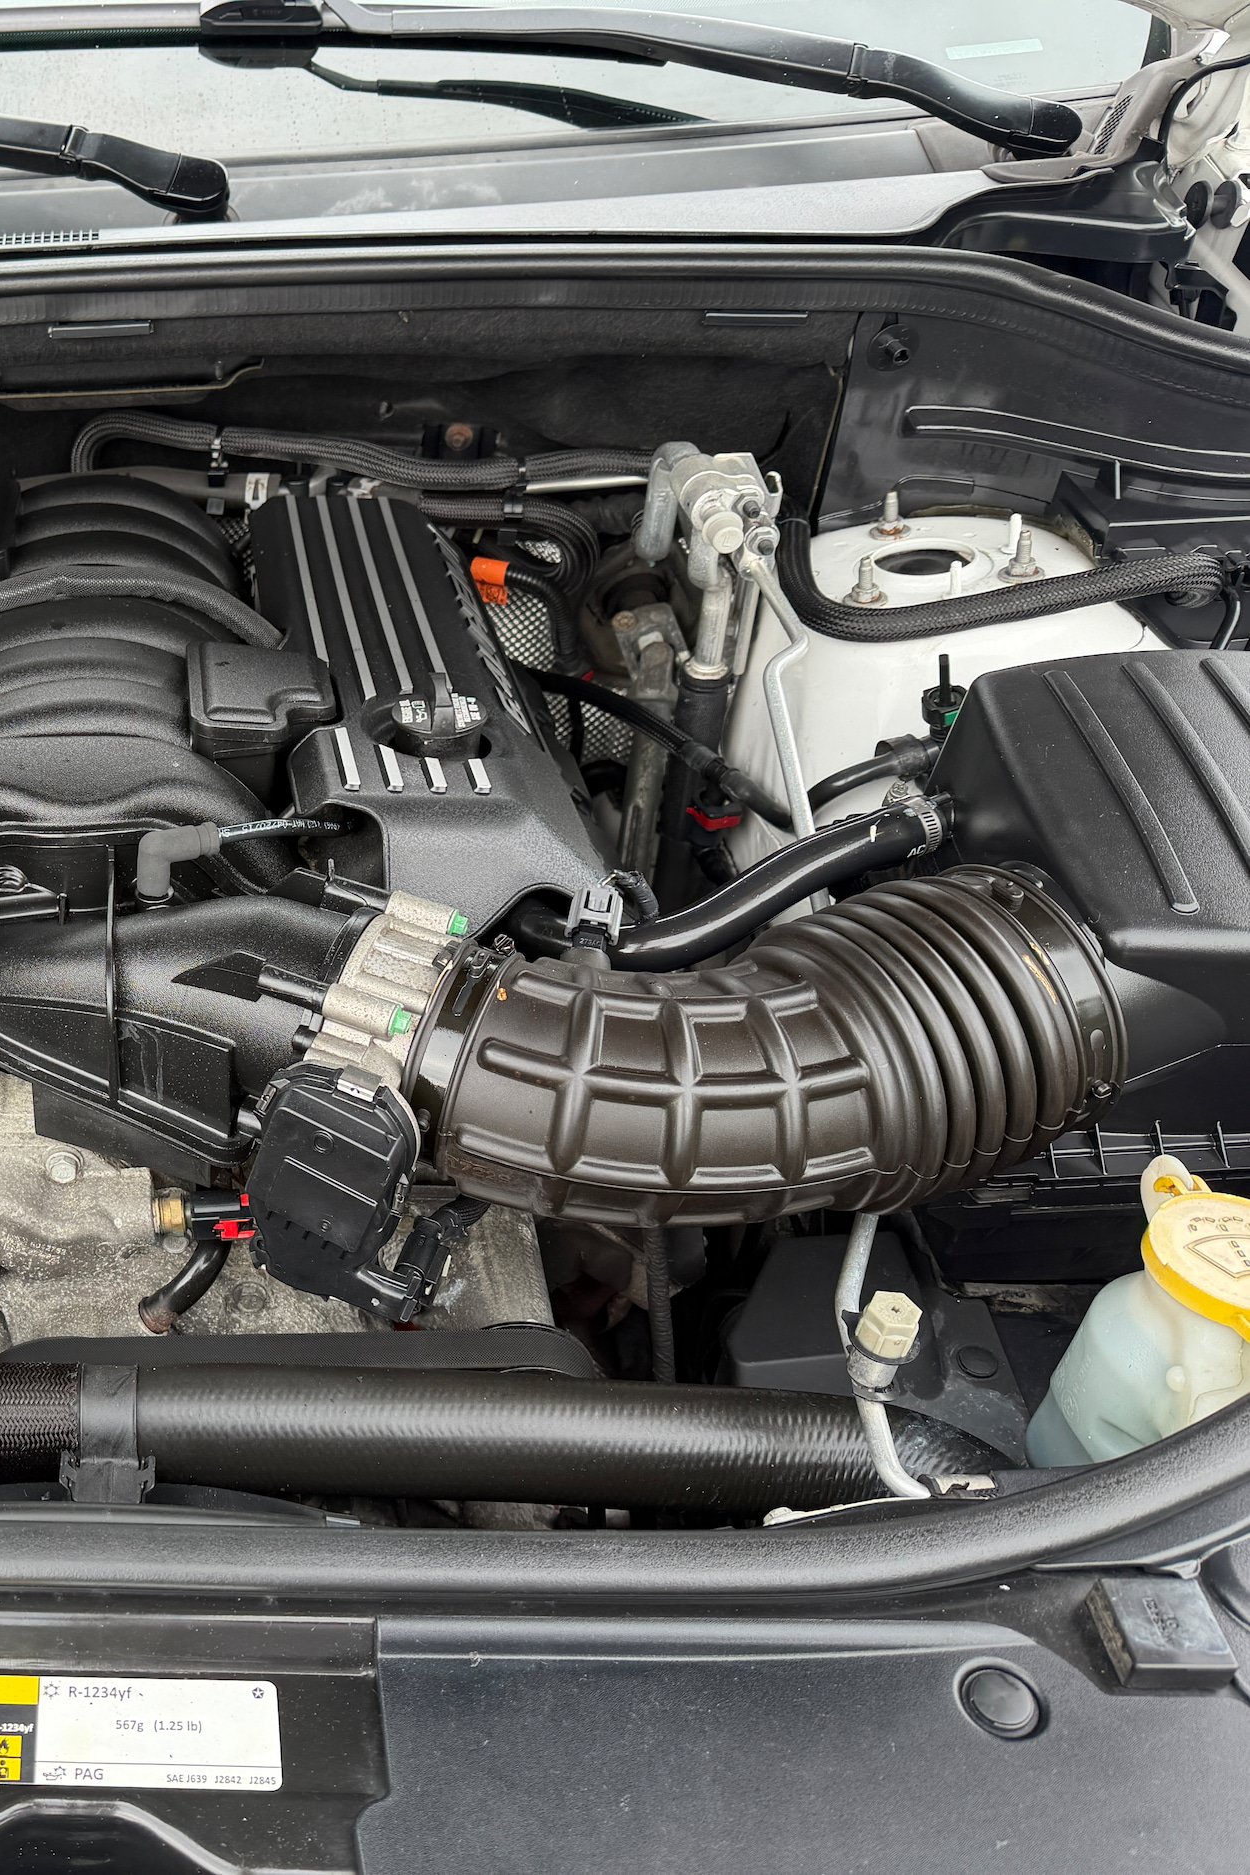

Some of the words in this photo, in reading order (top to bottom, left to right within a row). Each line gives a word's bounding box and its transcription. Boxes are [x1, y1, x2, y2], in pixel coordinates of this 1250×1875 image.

[68, 1686, 132, 1701] R-1234yf
[115, 1719, 144, 1732] 567g
[153, 1719, 184, 1733] (1.25
[187, 1720, 203, 1734] lb)
[74, 1767, 104, 1780] PAG
[166, 1773, 184, 1783] SAE
[186, 1774, 208, 1784] J639
[214, 1775, 242, 1785] J2842
[249, 1776, 277, 1785] J2845
